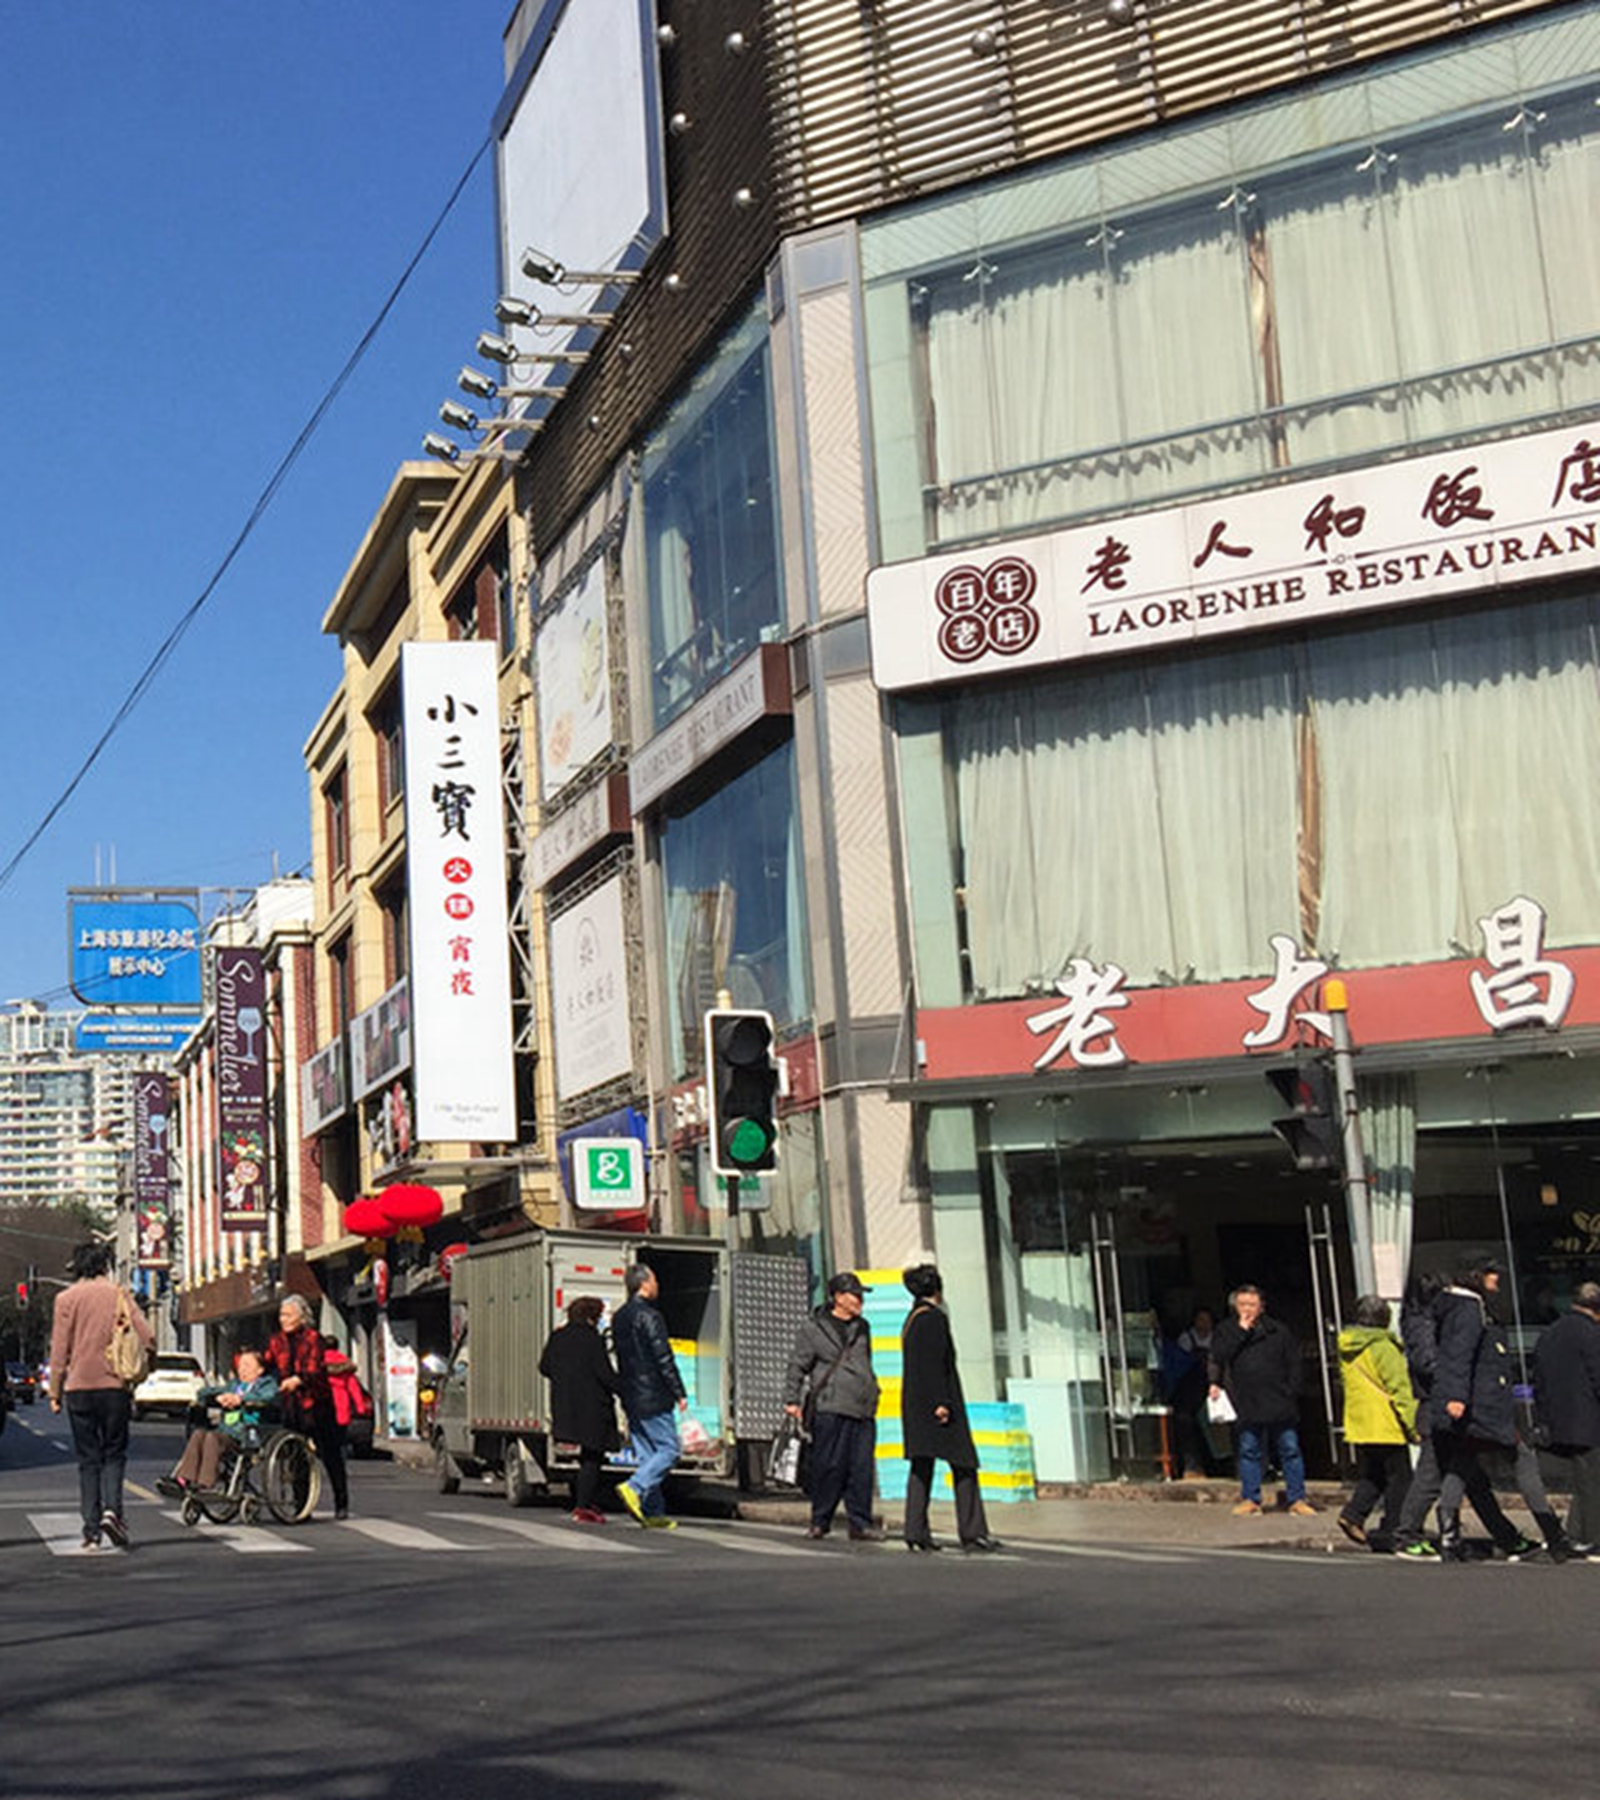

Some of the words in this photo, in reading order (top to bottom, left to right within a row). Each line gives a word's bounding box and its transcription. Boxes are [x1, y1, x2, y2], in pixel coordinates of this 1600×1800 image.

[1088, 575, 1307, 638] LAORENHE
[1326, 522, 1597, 596] RESTAURAN
[217, 953, 258, 1094] Sommelier
[1026, 897, 1575, 1070] 老大昌
